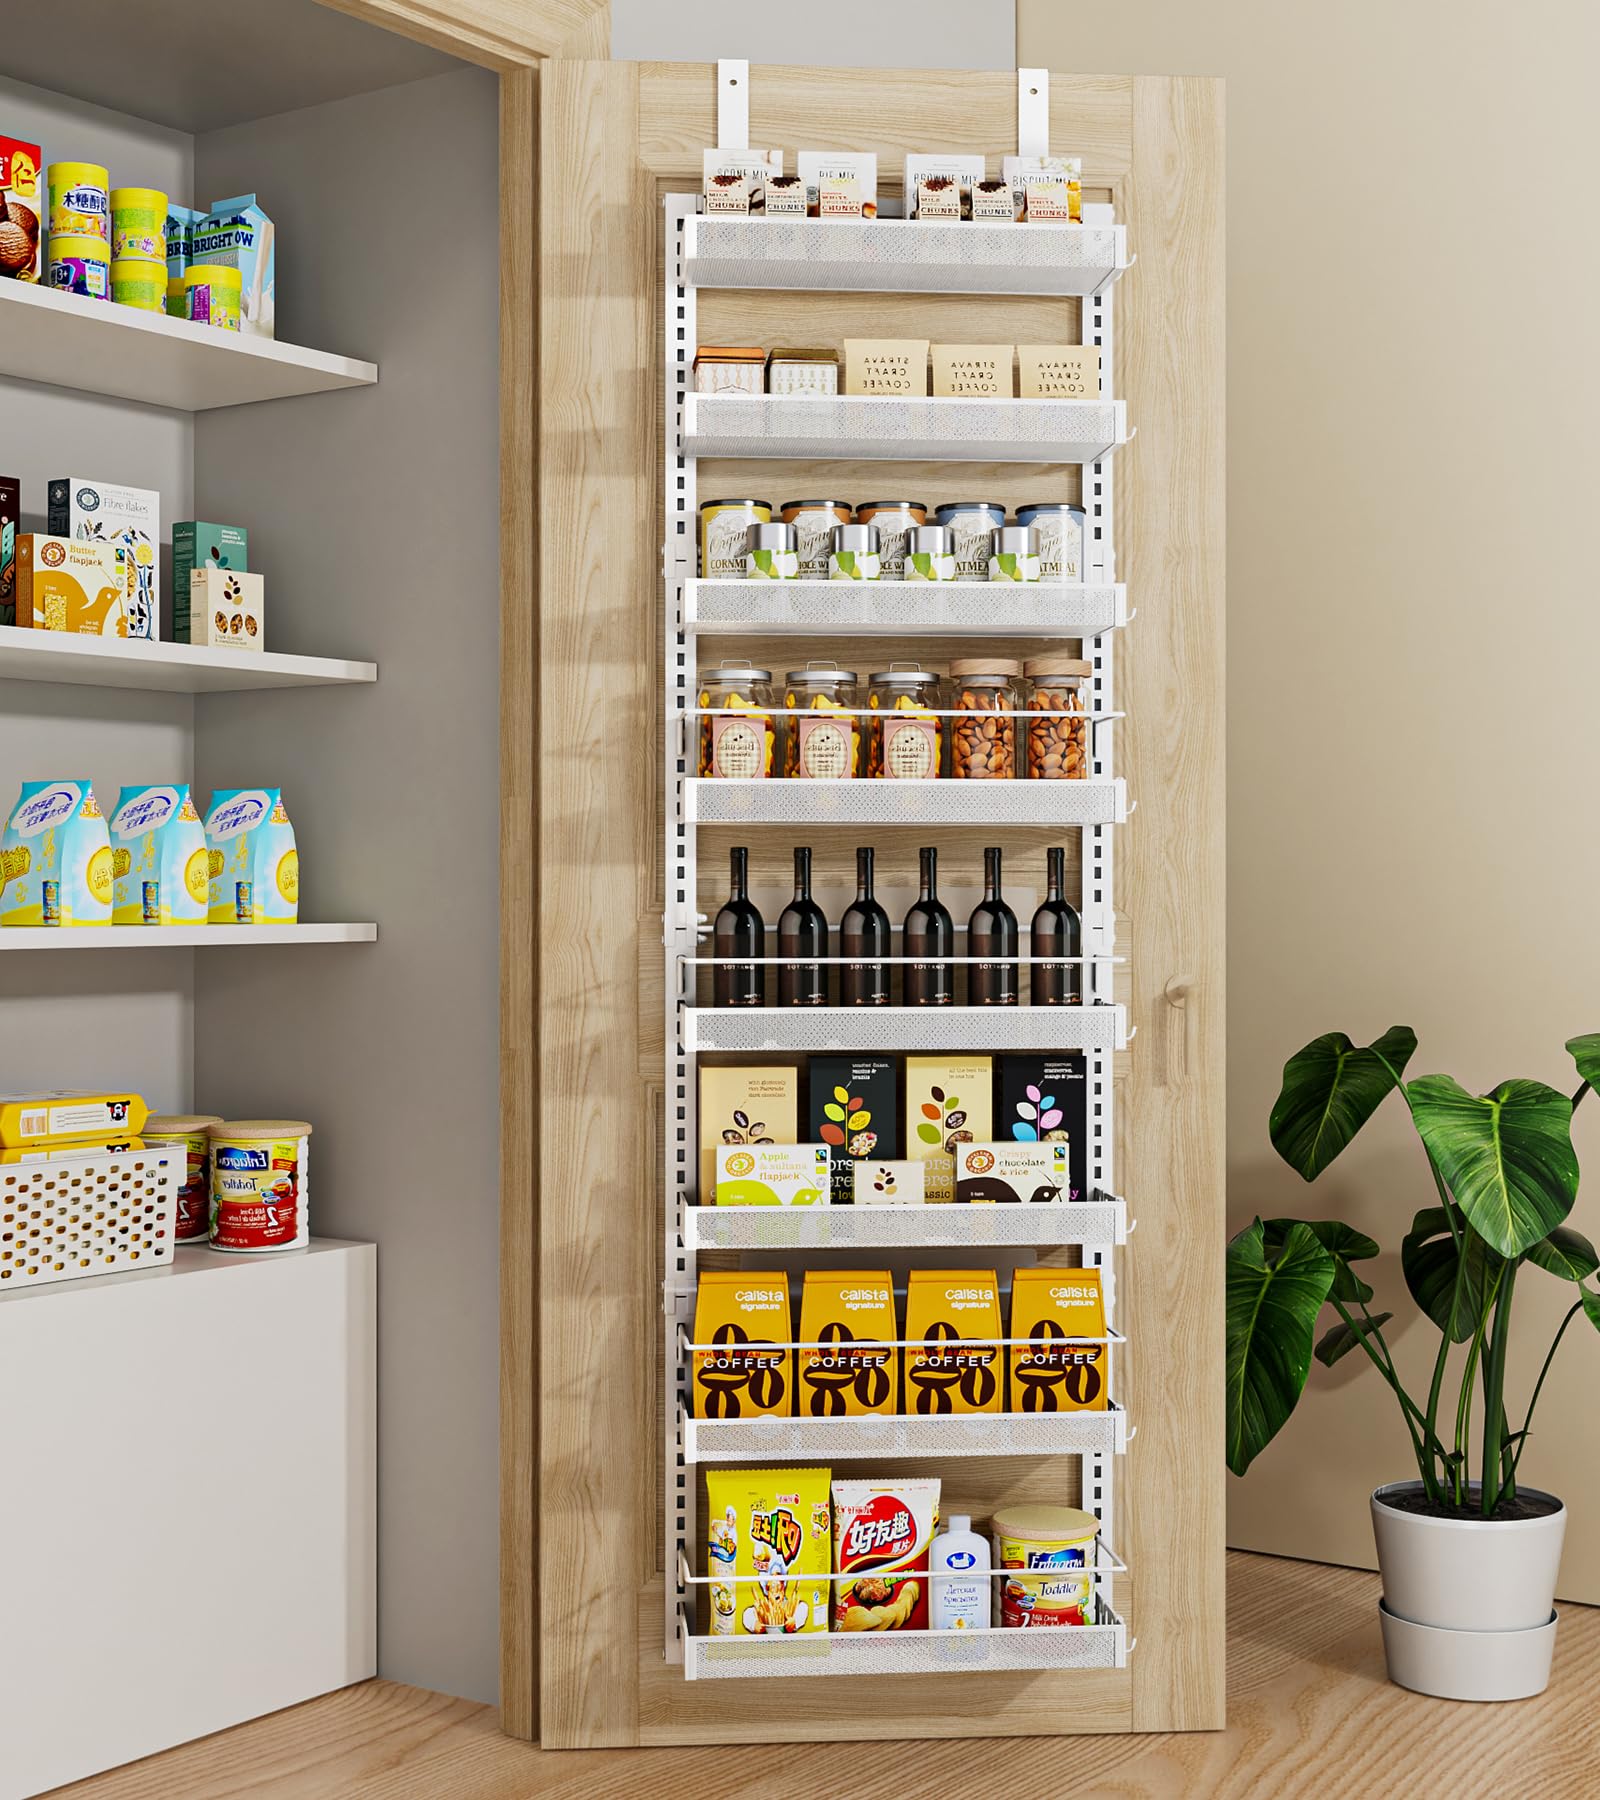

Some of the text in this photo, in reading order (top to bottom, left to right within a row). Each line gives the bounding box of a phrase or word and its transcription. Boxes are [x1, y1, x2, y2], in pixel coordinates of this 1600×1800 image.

[1029, 209, 1067, 217] CHUNKS
[193, 232, 234, 254] BRIGHT
[104, 497, 124, 510] Fibre
[69, 544, 97, 556] Butter
[69, 555, 103, 566] flapjack
[760, 1153, 789, 1161] Apple
[999, 1150, 1032, 1159] Crispy
[999, 1159, 1046, 1167] chocolate
[760, 1173, 800, 1182] flapjack
[1010, 1168, 1029, 1176] rice
[740, 1303, 781, 1312] signature
[845, 1302, 885, 1311] signature
[951, 1302, 990, 1310] signature
[1055, 1300, 1095, 1308] signature
[703, 1357, 781, 1369] COFFEE
[809, 1356, 885, 1368] COFFEE
[915, 1355, 991, 1367] COFFEE
[1020, 1353, 1096, 1364] COFFEE
[846, 1511, 910, 1556] 好友趣
[1038, 1582, 1079, 1596] Toddler
[1021, 1612, 1030, 1627] 2
